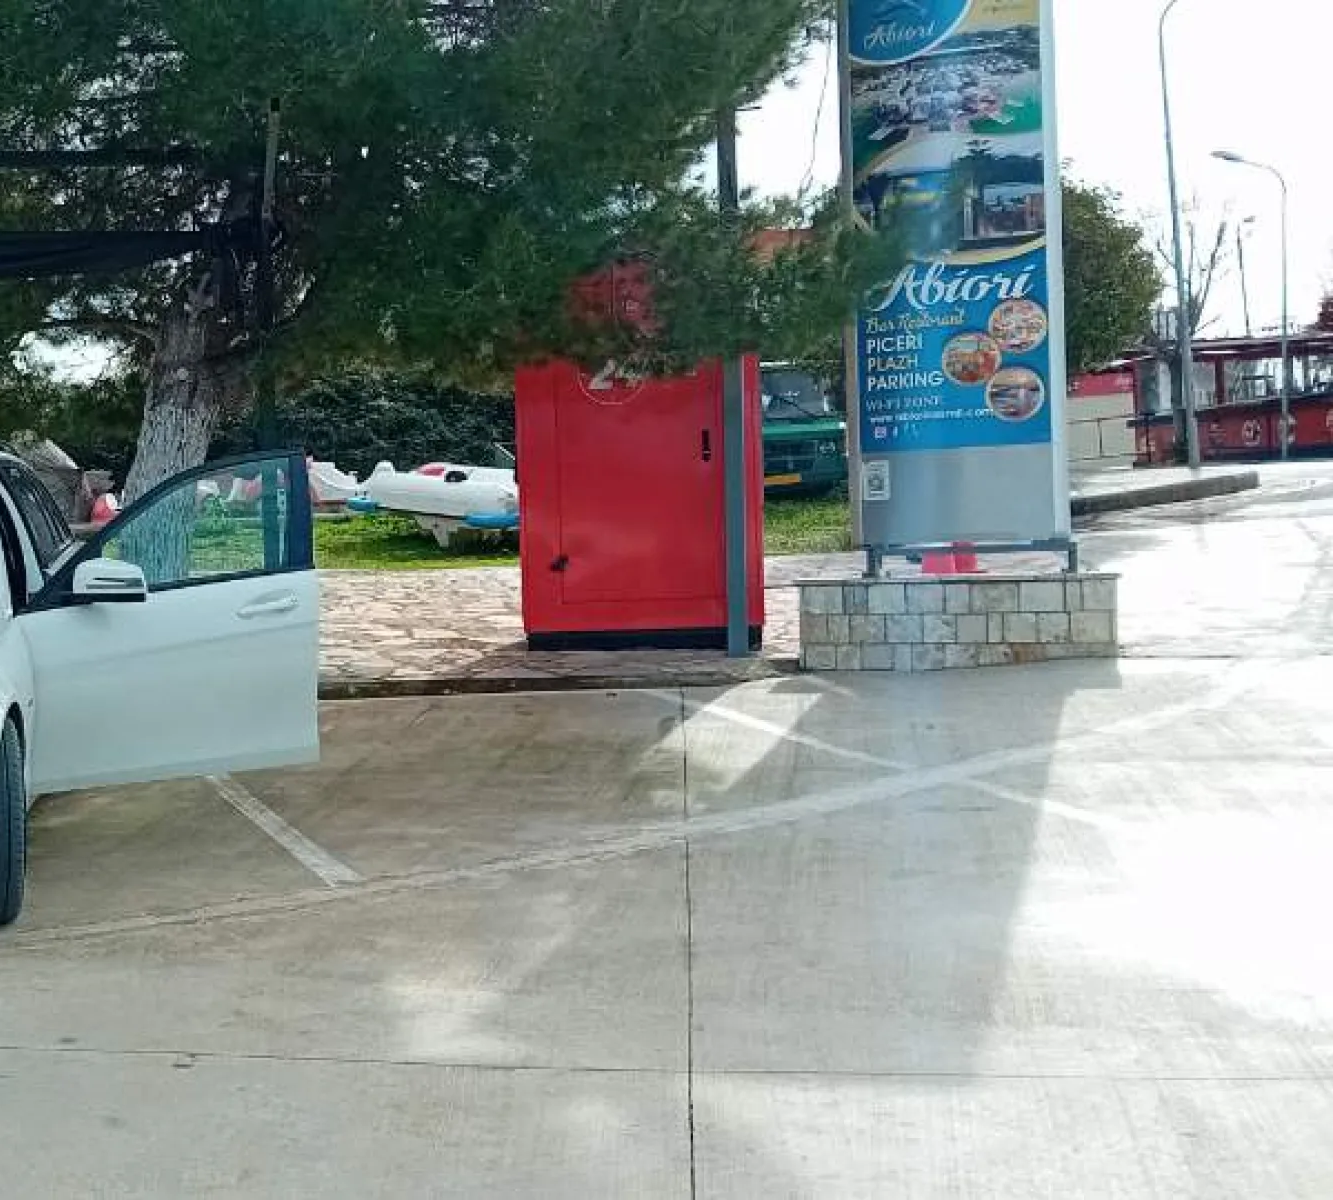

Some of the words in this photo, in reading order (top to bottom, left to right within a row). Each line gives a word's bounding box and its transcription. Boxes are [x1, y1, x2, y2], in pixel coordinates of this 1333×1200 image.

[866, 260, 1037, 312] Abiori
[866, 333, 923, 354] PICERI
[867, 353, 918, 373] PLAZH
[867, 370, 945, 392] PARKING
